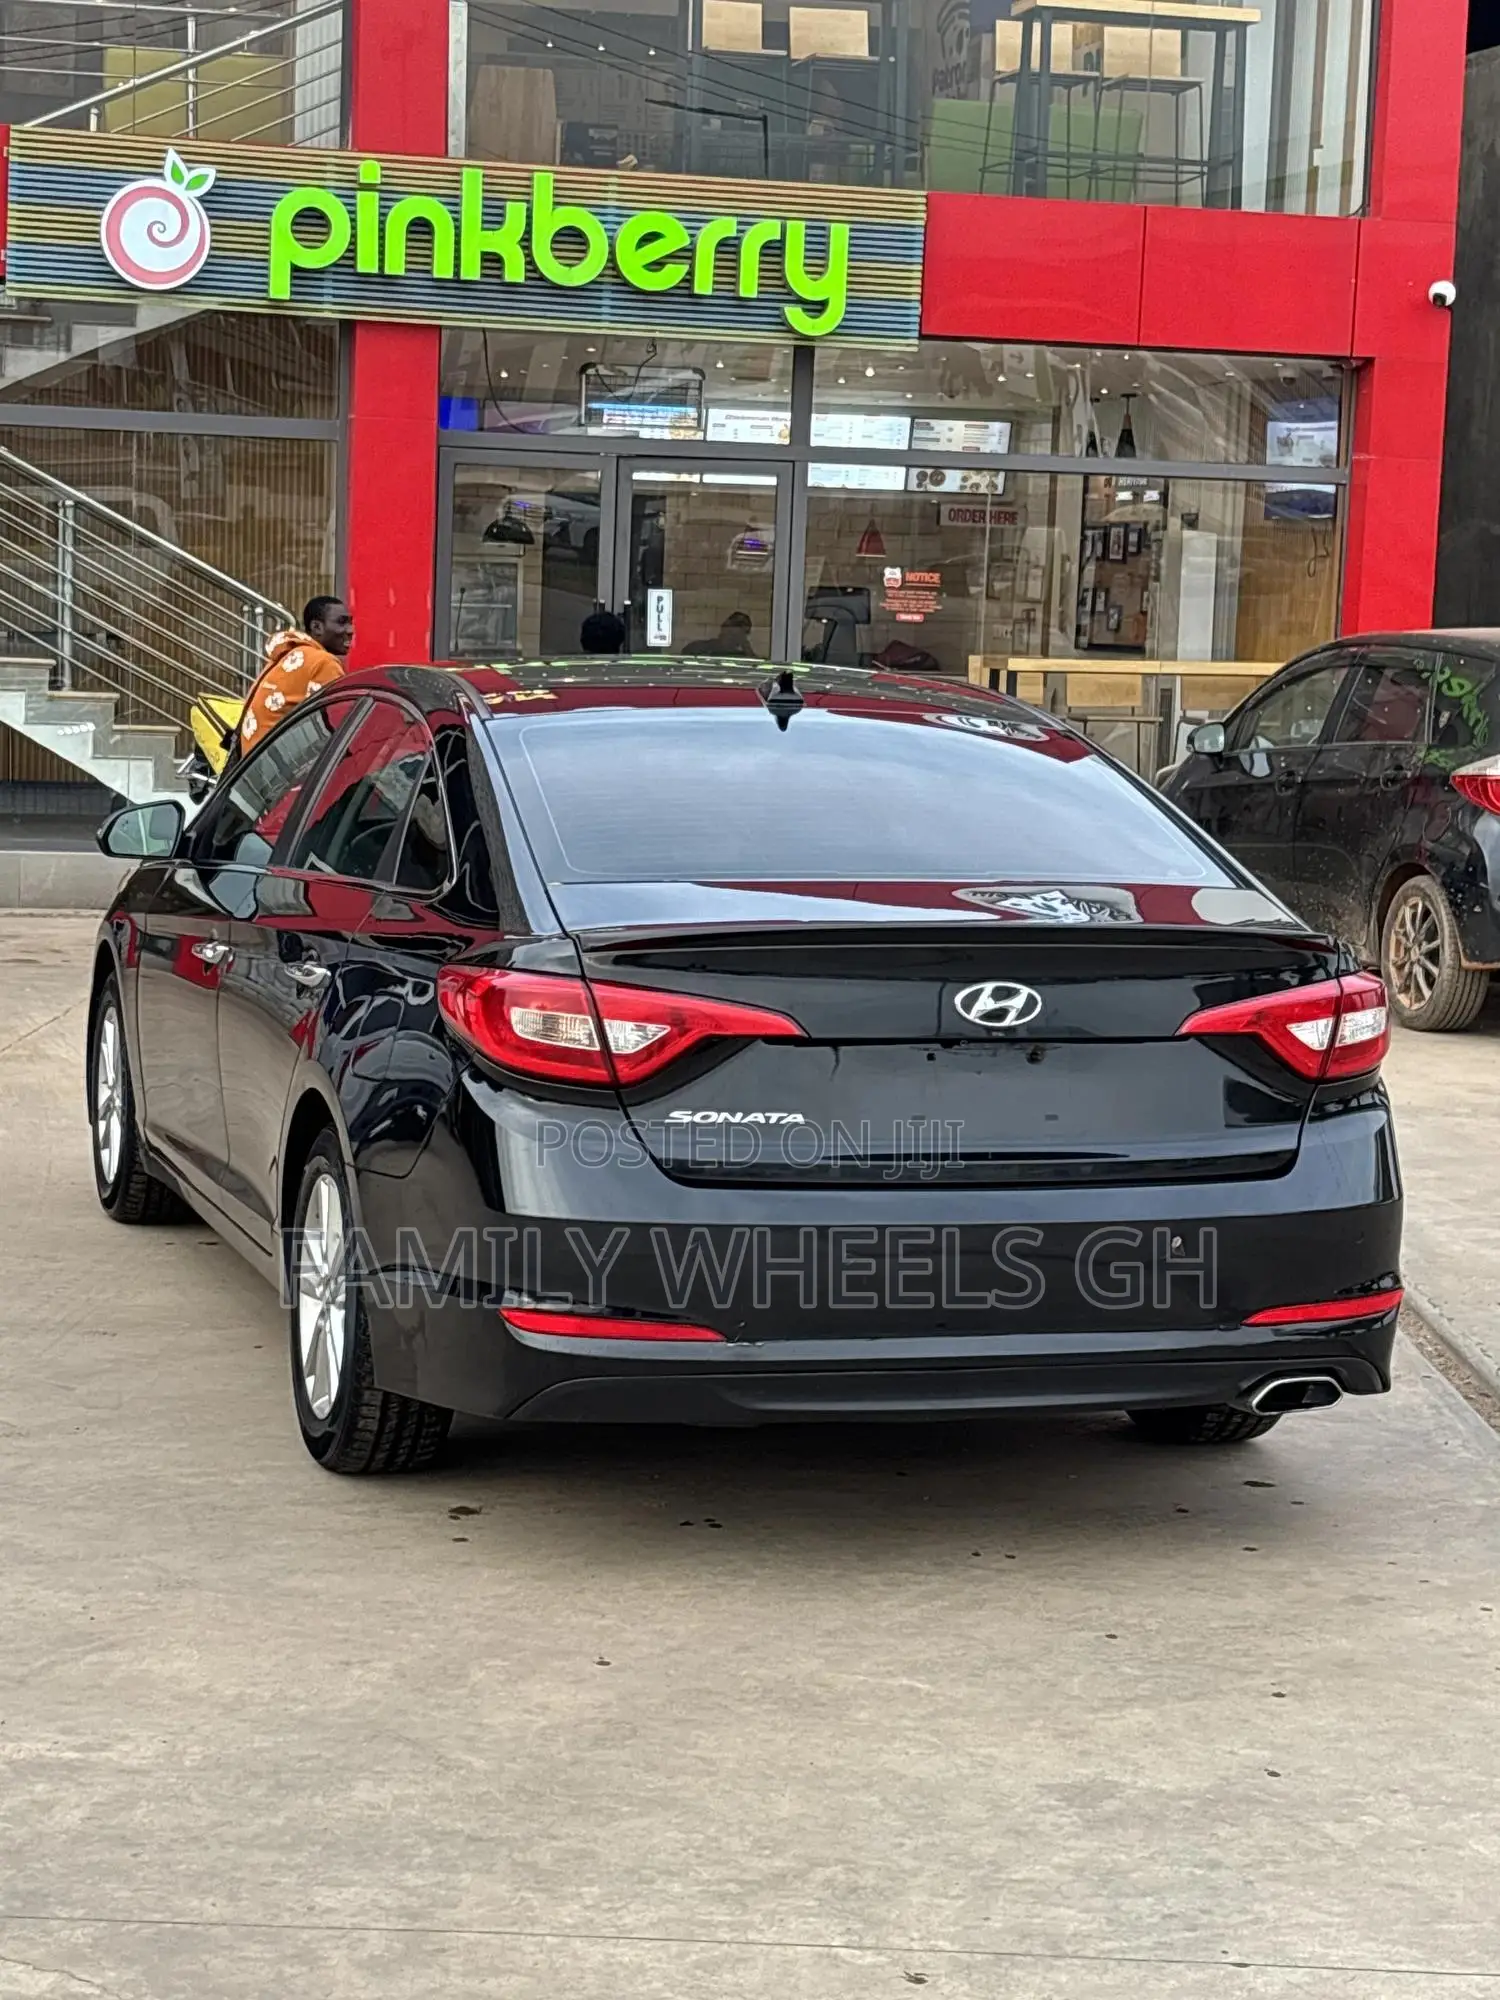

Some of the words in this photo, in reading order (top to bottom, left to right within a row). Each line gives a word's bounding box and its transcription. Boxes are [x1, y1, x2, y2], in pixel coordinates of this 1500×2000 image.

[268, 160, 850, 337] pinkberry
[948, 507, 987, 524] ORDER
[989, 509, 1018, 525] HERE
[904, 571, 941, 584] NOTICE
[656, 595, 664, 632] PULL
[664, 1110, 806, 1124] SONATA
